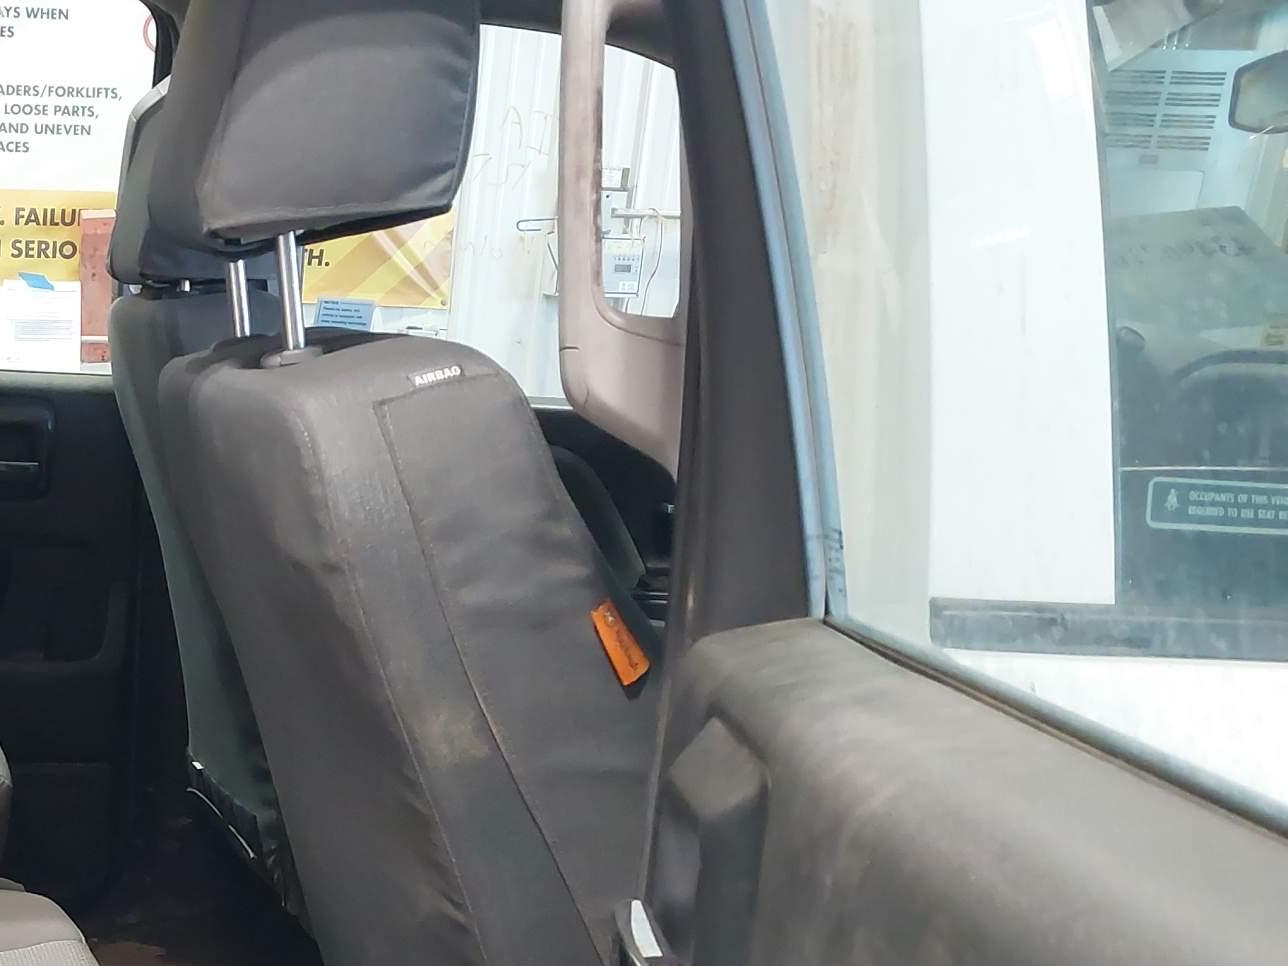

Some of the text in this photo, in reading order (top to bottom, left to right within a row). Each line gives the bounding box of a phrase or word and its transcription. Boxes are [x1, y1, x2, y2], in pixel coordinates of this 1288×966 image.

[26, 7, 69, 20] WHEN
[4, 103, 48, 116] LOOSE
[54, 105, 99, 119] PARTS,
[34, 123, 91, 136] UNEVEN
[15, 208, 81, 226] FAILU
[305, 248, 330, 267] H.
[413, 366, 462, 386] AIRBAG
